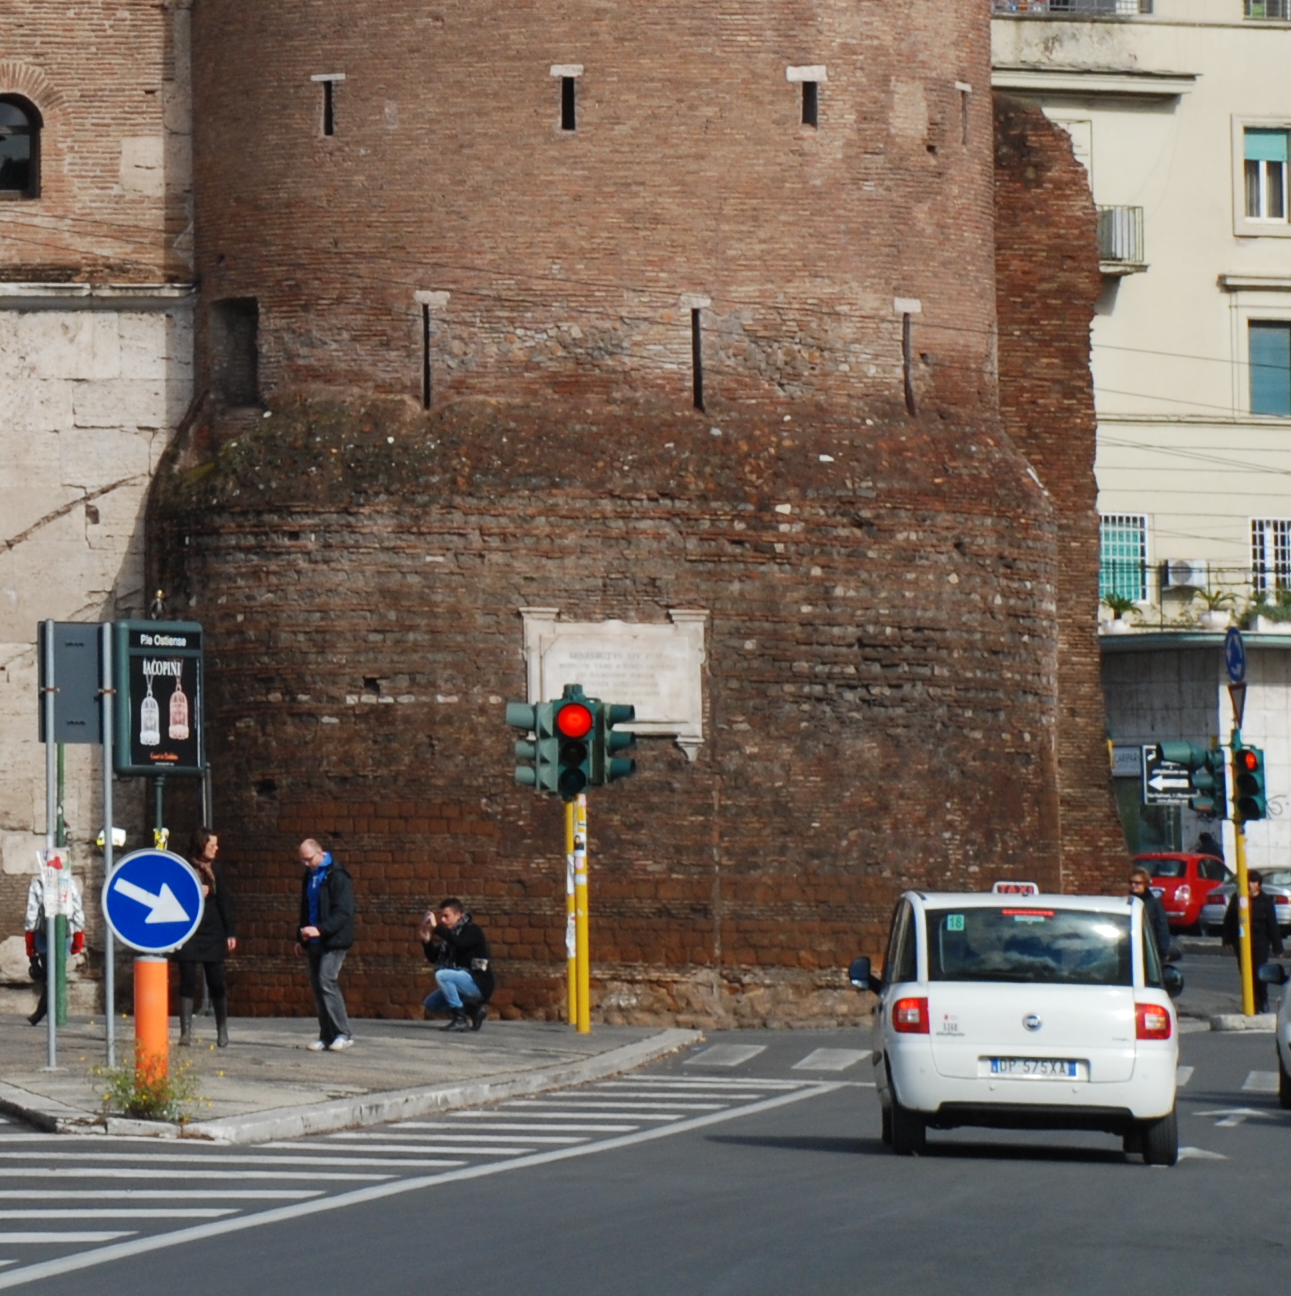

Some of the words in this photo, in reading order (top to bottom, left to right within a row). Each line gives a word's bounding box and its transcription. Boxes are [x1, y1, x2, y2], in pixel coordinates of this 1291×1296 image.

[142, 659, 181, 676] IACOPINI
[998, 884, 1035, 894] TAXI
[949, 916, 963, 929] 18
